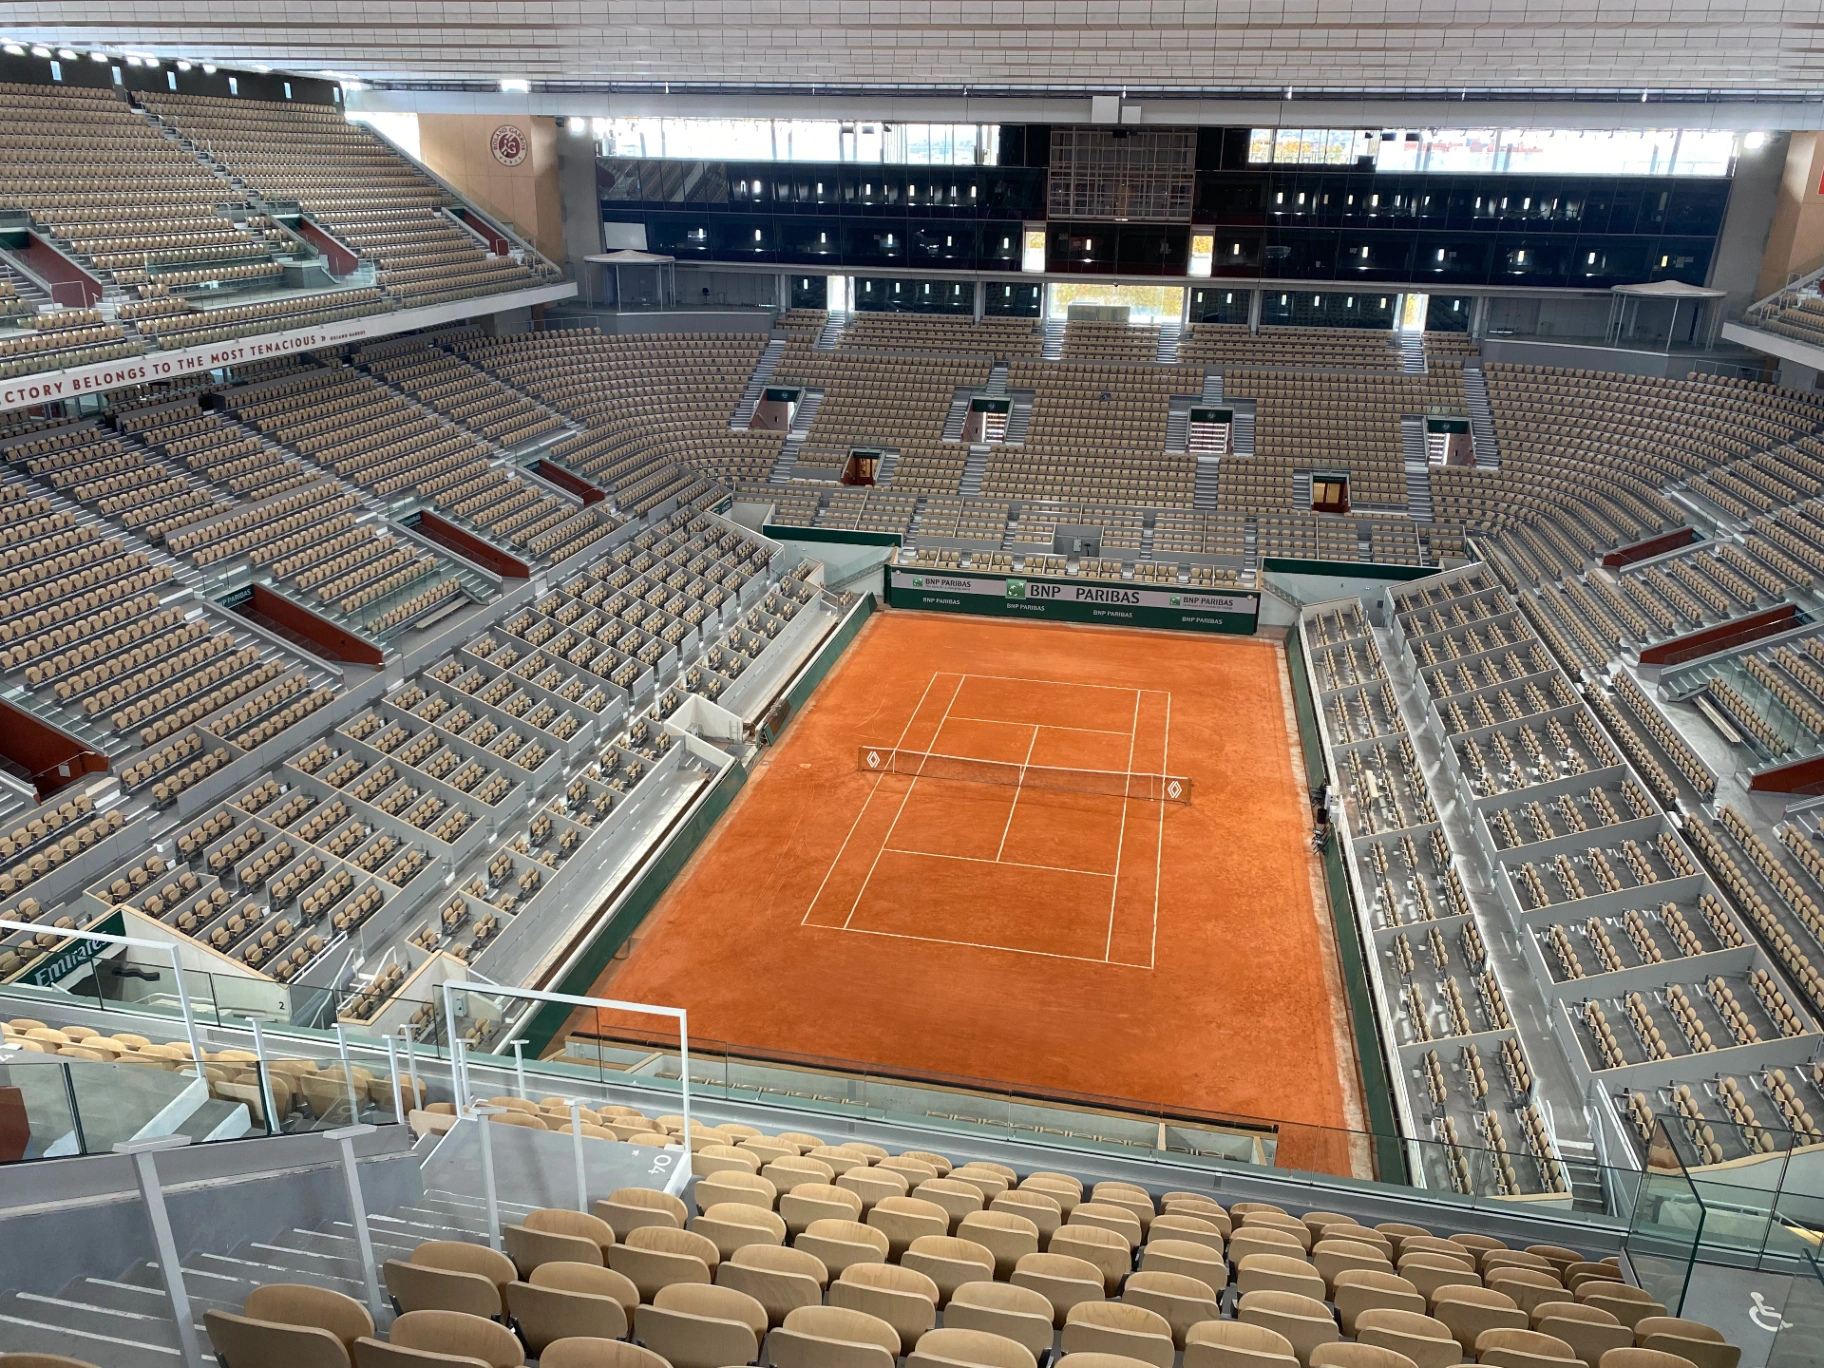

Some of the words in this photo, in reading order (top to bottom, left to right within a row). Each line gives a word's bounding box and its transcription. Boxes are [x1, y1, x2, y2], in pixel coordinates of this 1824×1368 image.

[0, 382, 62, 405] CTORY
[73, 366, 146, 391] BELONGS
[152, 362, 171, 375] TO
[177, 355, 204, 370] THE
[211, 348, 244, 364] MOST
[250, 334, 316, 356] TENACIOUS
[925, 578, 940, 586] BNP
[941, 579, 971, 588] PARIBAS
[1030, 584, 1061, 598] BNP
[1075, 587, 1140, 604] PARIBAS
[1183, 596, 1199, 604] BNP
[1200, 597, 1234, 607] PARIBAS
[1020, 603, 1045, 611] PARIBAS
[1196, 617, 1223, 625] PARIBAS
[278, 1001, 286, 1010] 2
[647, 1154, 672, 1175] 04
